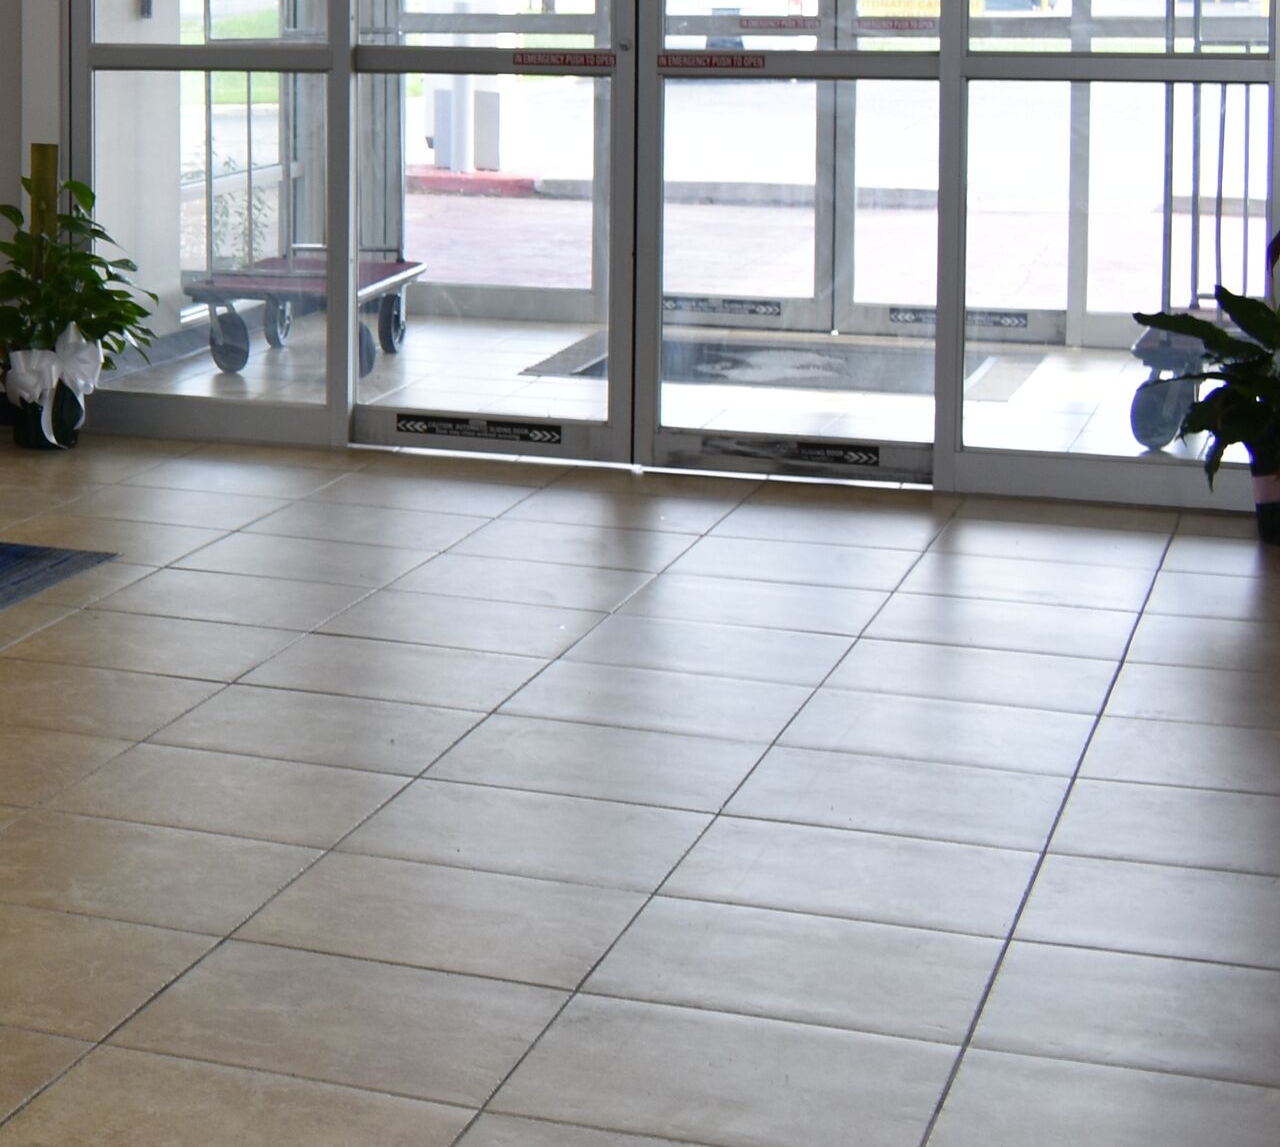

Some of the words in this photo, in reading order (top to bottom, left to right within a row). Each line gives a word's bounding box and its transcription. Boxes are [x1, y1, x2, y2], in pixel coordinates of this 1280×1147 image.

[515, 54, 522, 65] IN
[524, 54, 564, 65] EMERGENCY
[565, 54, 584, 65] PUSH
[585, 54, 595, 65] TO
[596, 54, 614, 65] OPEN
[659, 56, 667, 66] IN
[668, 56, 711, 66] EMERGENCY
[712, 56, 732, 66] PUSH
[733, 56, 743, 66] TO
[744, 56, 763, 66] OPEN
